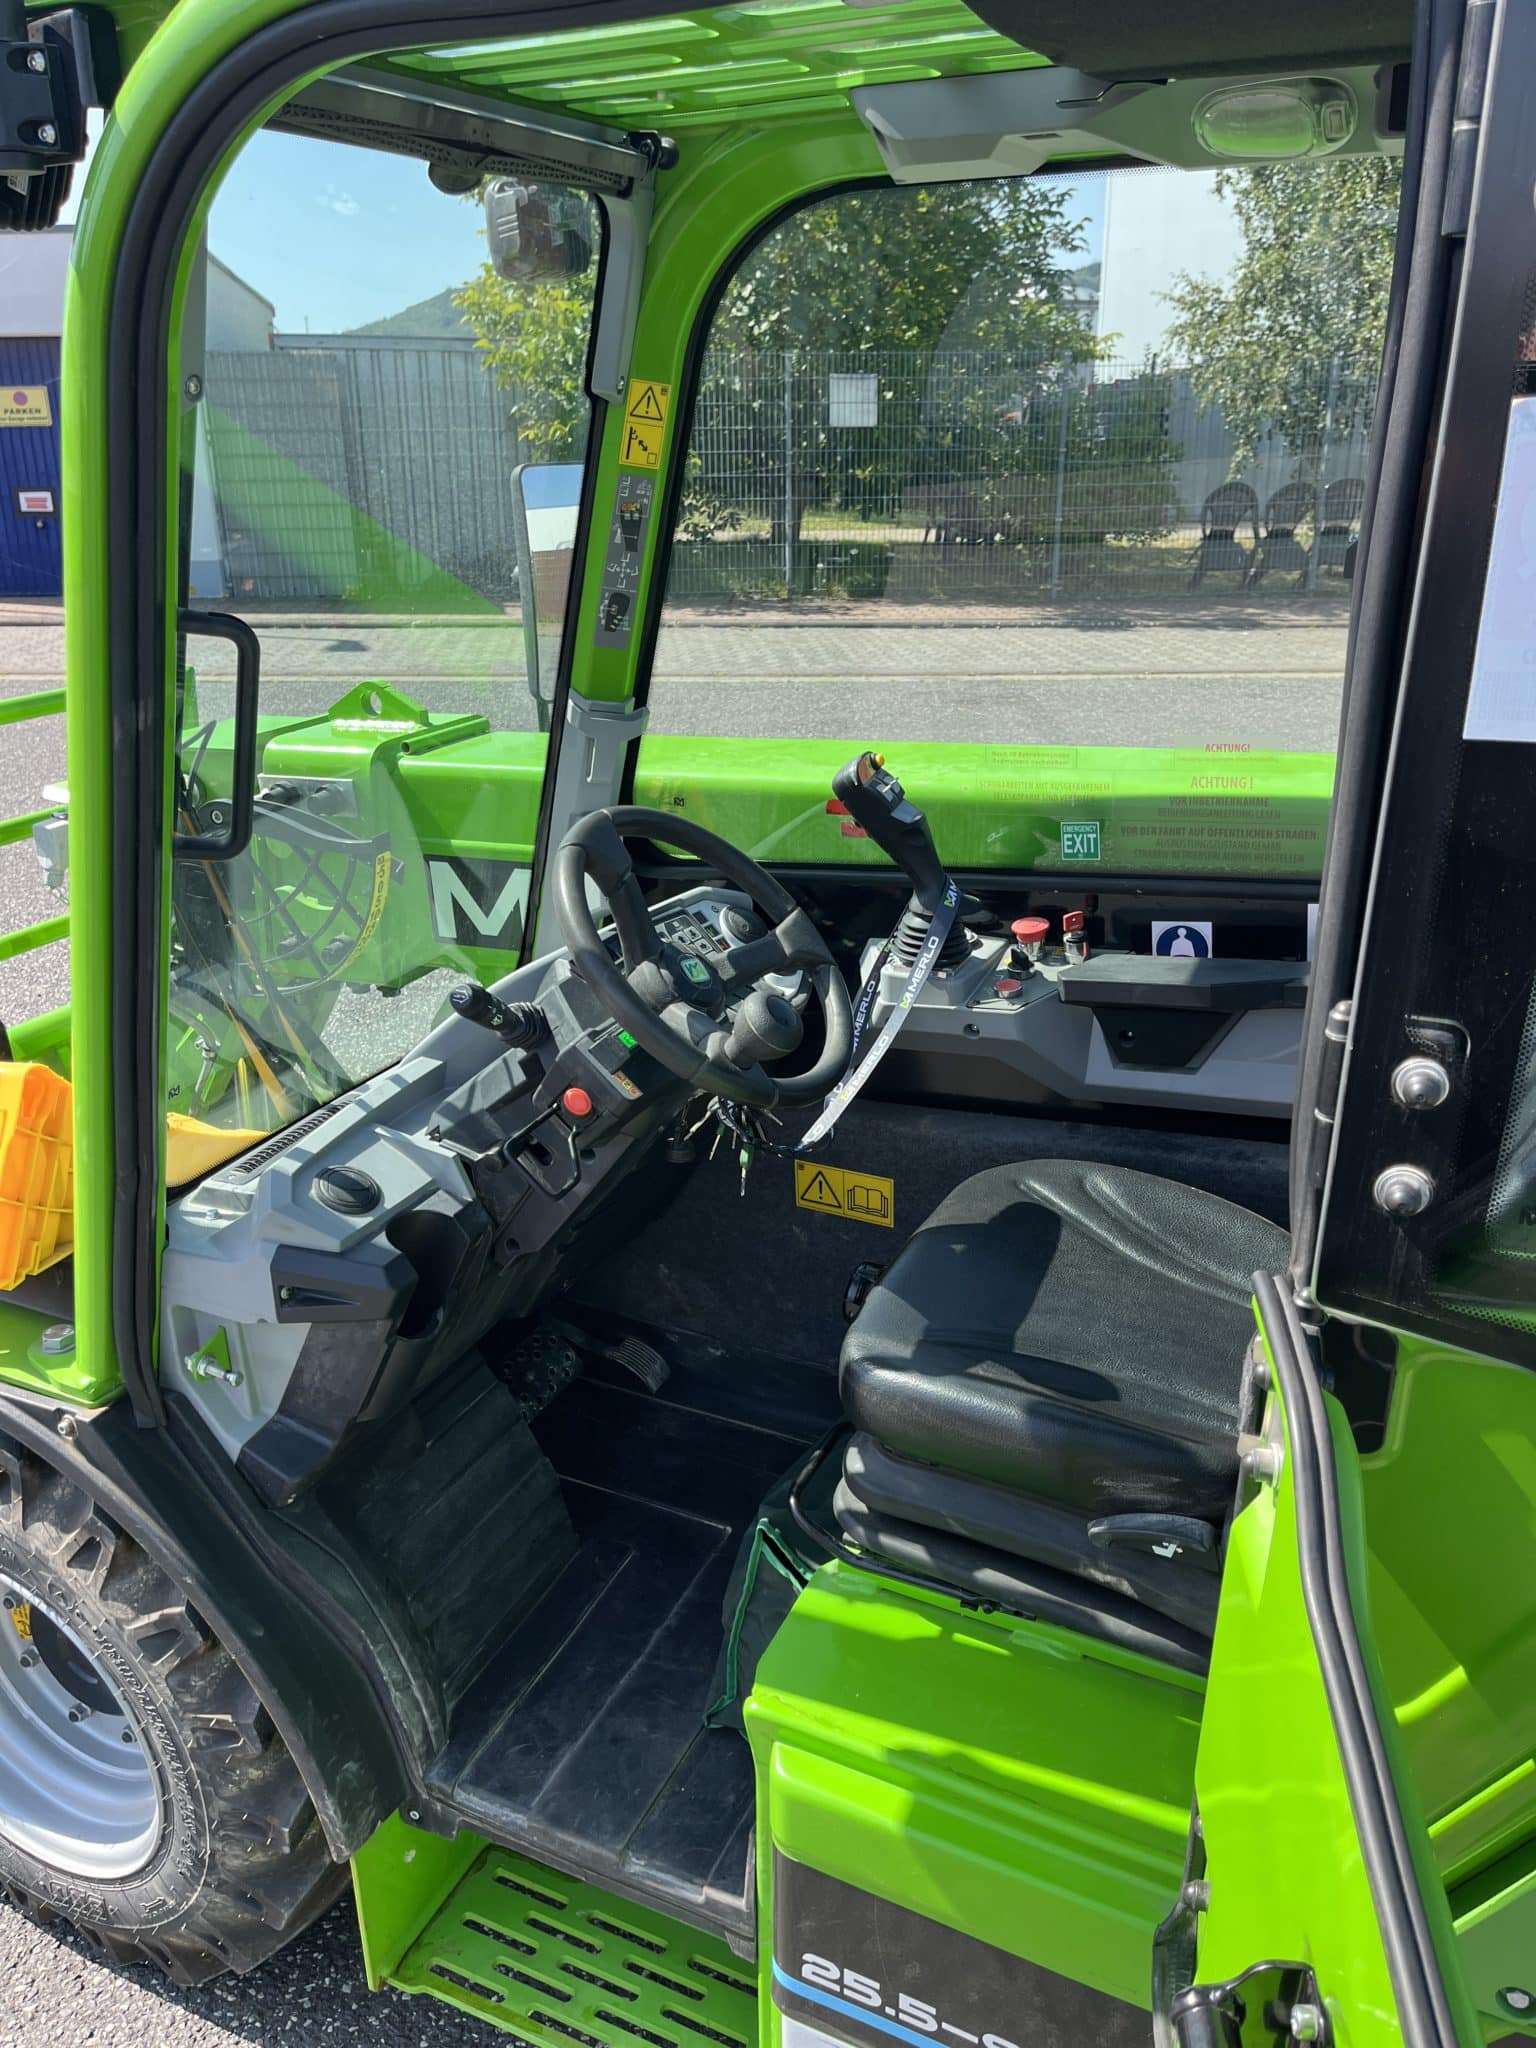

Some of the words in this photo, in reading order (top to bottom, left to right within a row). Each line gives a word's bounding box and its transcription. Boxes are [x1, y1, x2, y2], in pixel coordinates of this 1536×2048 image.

[1204, 743, 1251, 753] ACHTUNG!
[1190, 776, 1247, 789] ACHTUNG
[1063, 824, 1097, 833] EMERGENCY
[1159, 827, 1186, 837] FAHRT
[1188, 828, 1206, 838] AUF
[1063, 833, 1097, 854] EXIT
[908, 936, 939, 993] MERLO
[854, 980, 876, 1037] MERLO
[851, 1034, 889, 1087] MERLO
